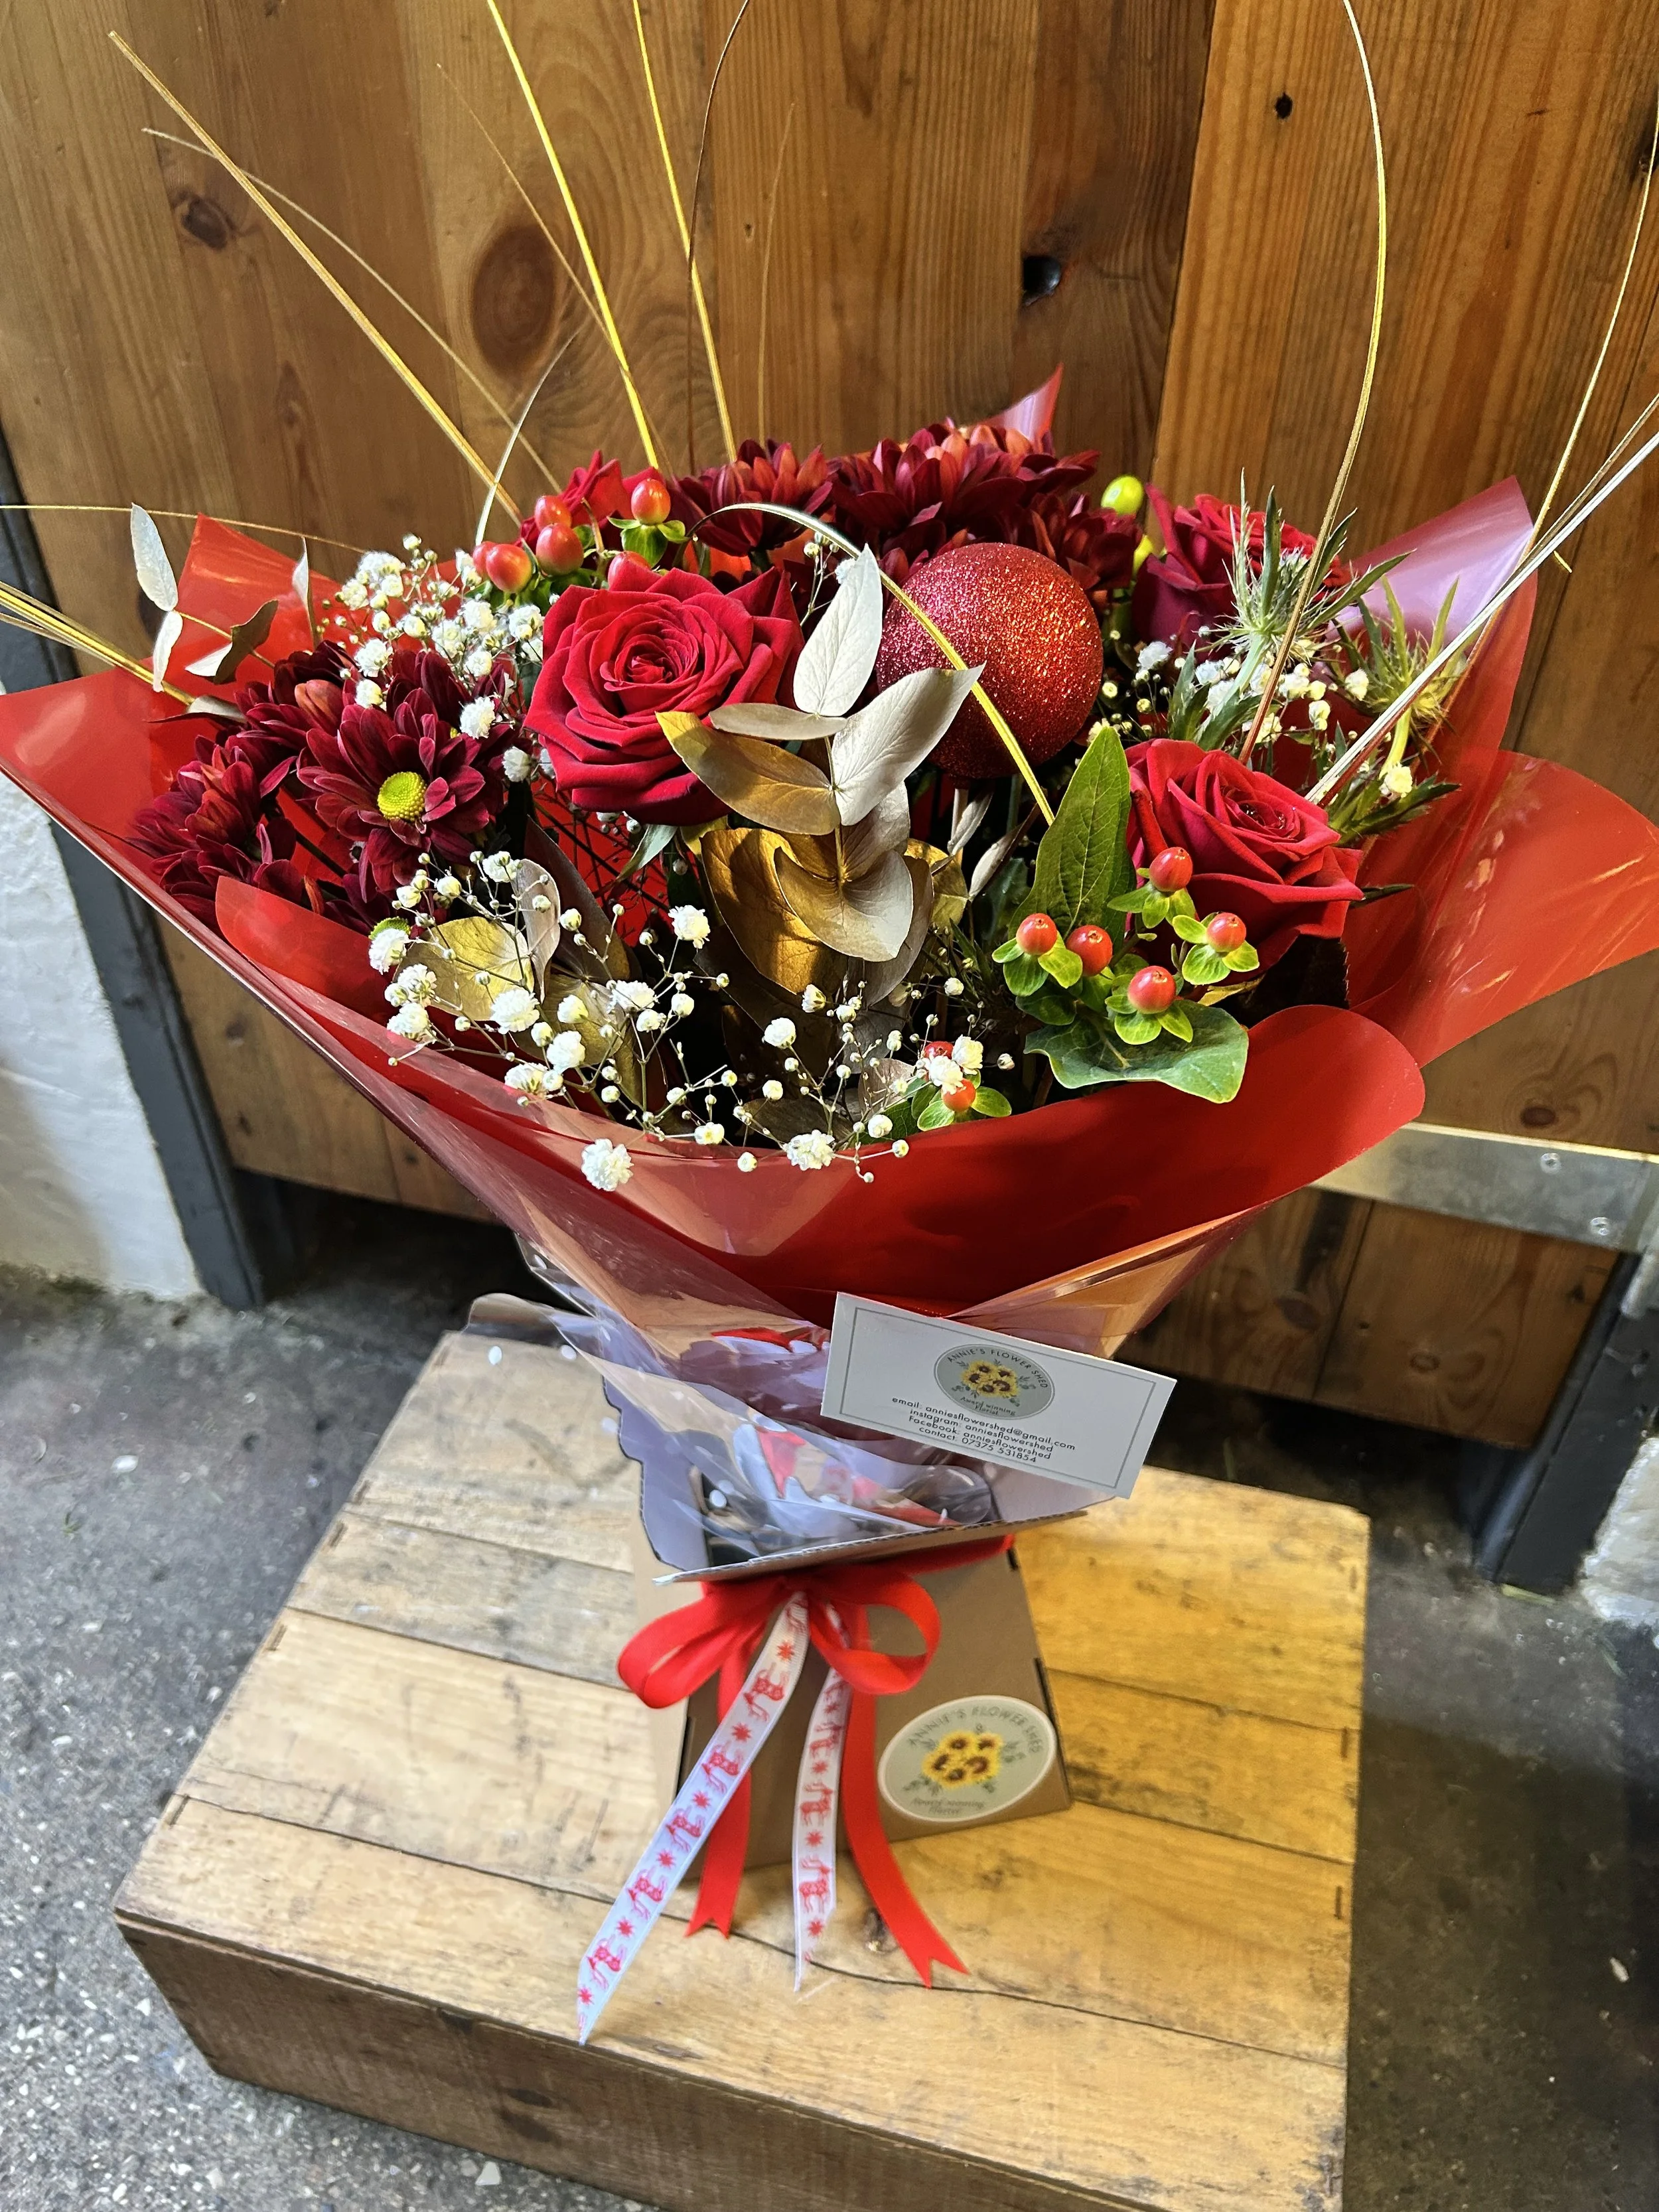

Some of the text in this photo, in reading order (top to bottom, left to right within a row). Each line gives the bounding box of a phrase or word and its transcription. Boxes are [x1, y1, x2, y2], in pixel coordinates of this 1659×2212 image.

[948, 1349, 1048, 1388] ANNIE'S FLOWER SHED
[926, 1407, 1075, 1450] anniesflowershed@gmail.com
[965, 1424, 1053, 1452] anniesflowershed
[962, 1437, 993, 1451] 07375
[997, 1447, 1036, 1463] 531854
[964, 1432, 1051, 1459] anniesflowershed
